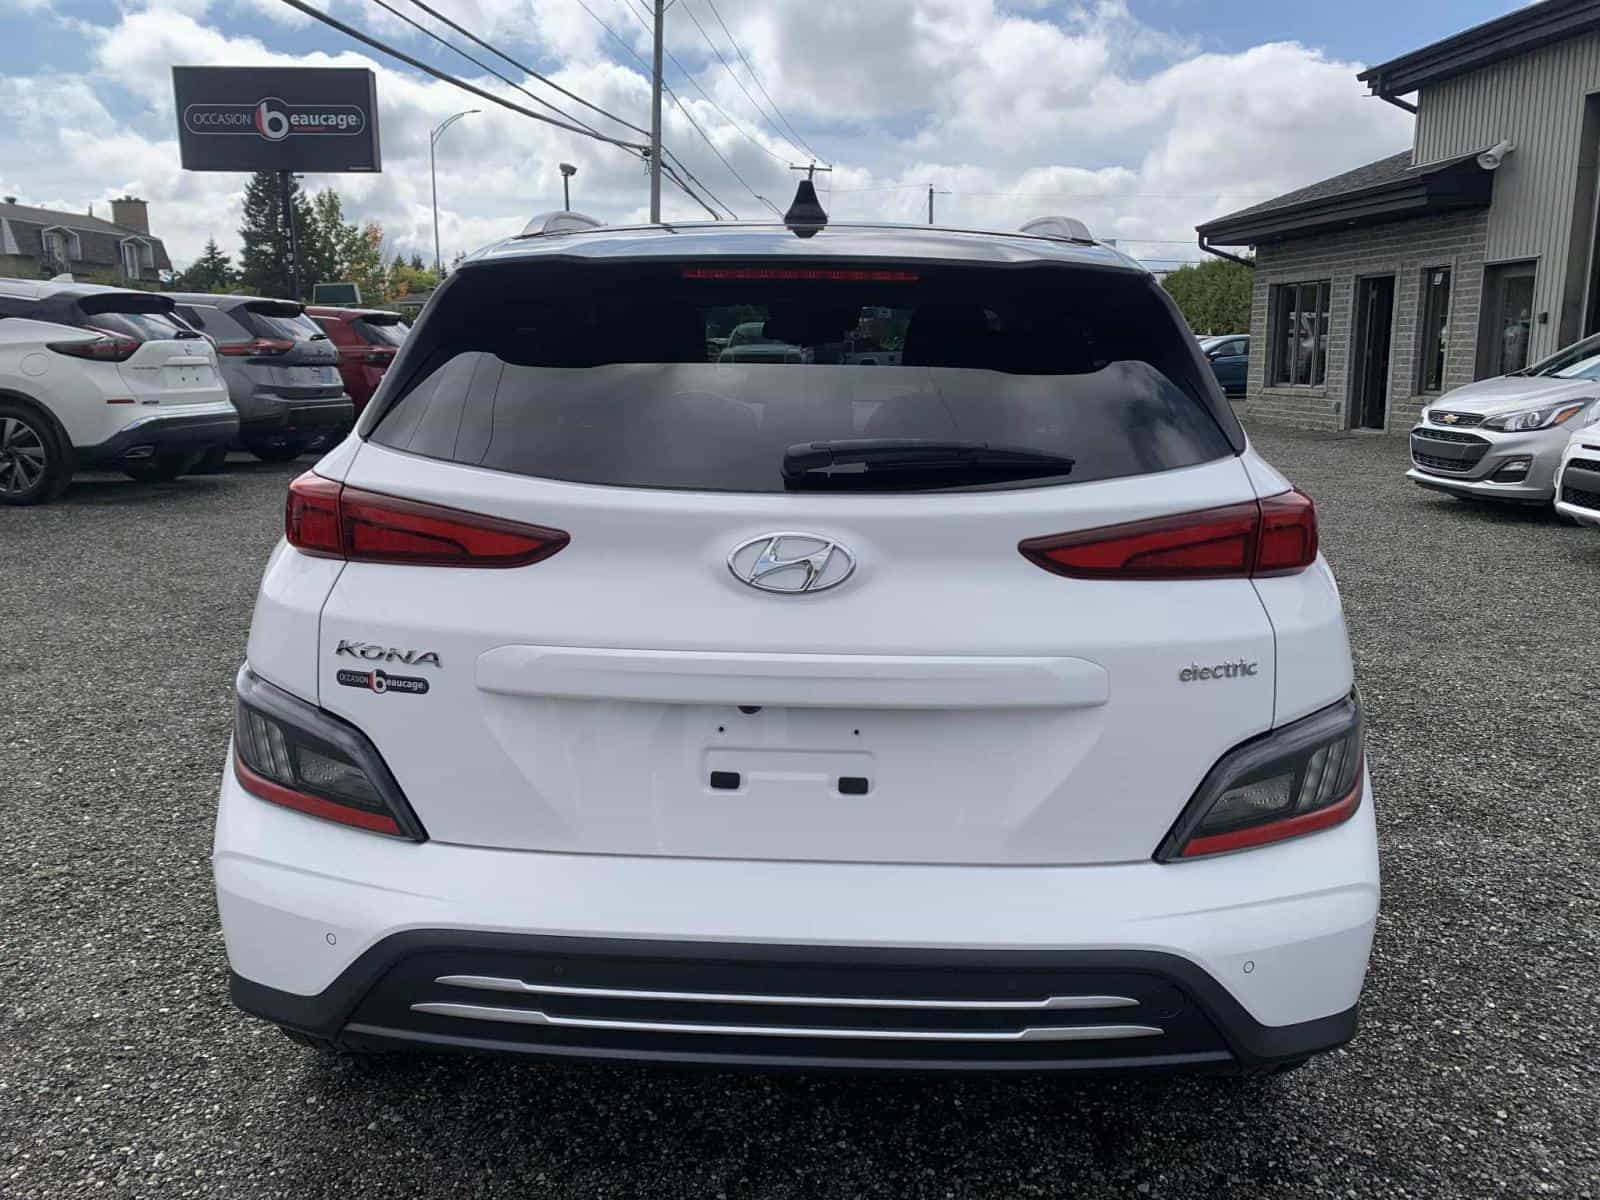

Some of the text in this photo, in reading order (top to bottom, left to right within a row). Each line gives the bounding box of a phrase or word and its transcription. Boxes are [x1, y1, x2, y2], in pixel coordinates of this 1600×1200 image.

[192, 112, 250, 126] OCCASION
[336, 640, 442, 668] KONA
[1179, 660, 1258, 682] electric
